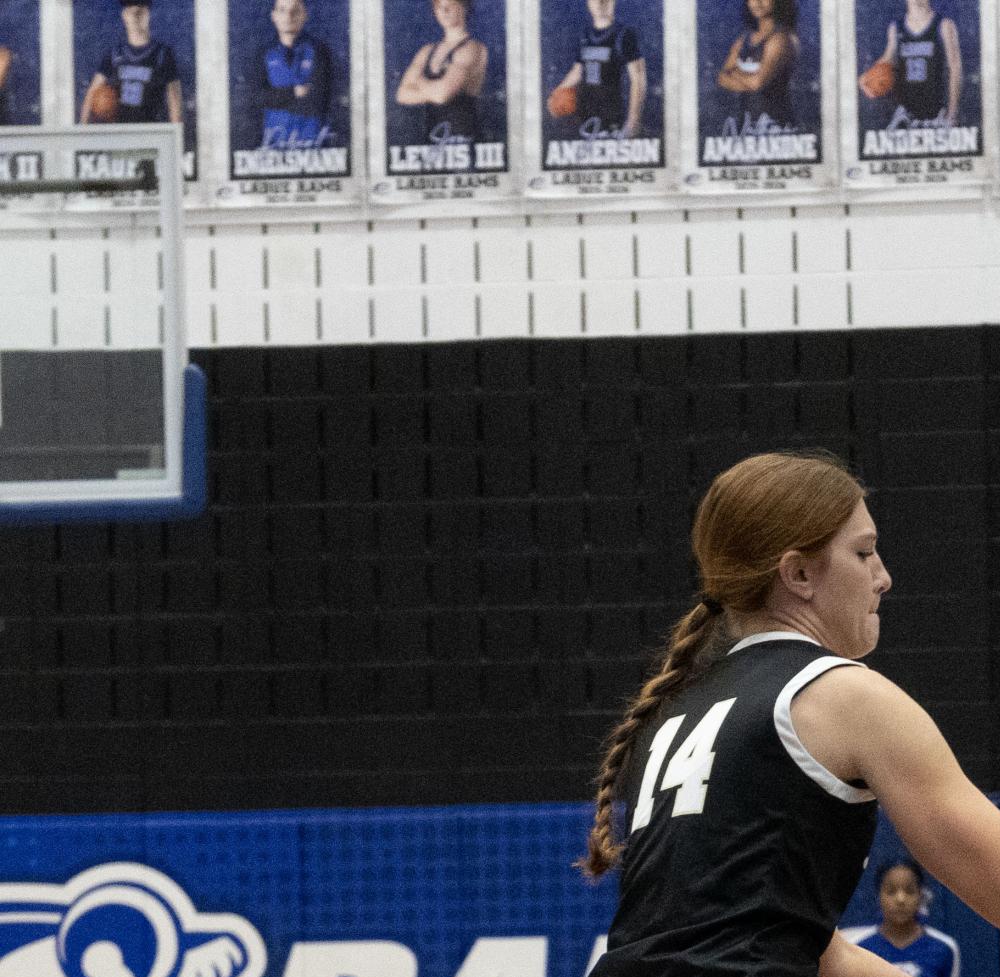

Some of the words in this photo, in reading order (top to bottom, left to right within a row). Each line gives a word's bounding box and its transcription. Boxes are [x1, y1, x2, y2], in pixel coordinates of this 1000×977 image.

[546, 138, 660, 165] ANDERSON
[864, 126, 978, 155] ANDERSON
[389, 144, 470, 170] LEWIS
[474, 142, 505, 168] III
[631, 697, 738, 834] 14
